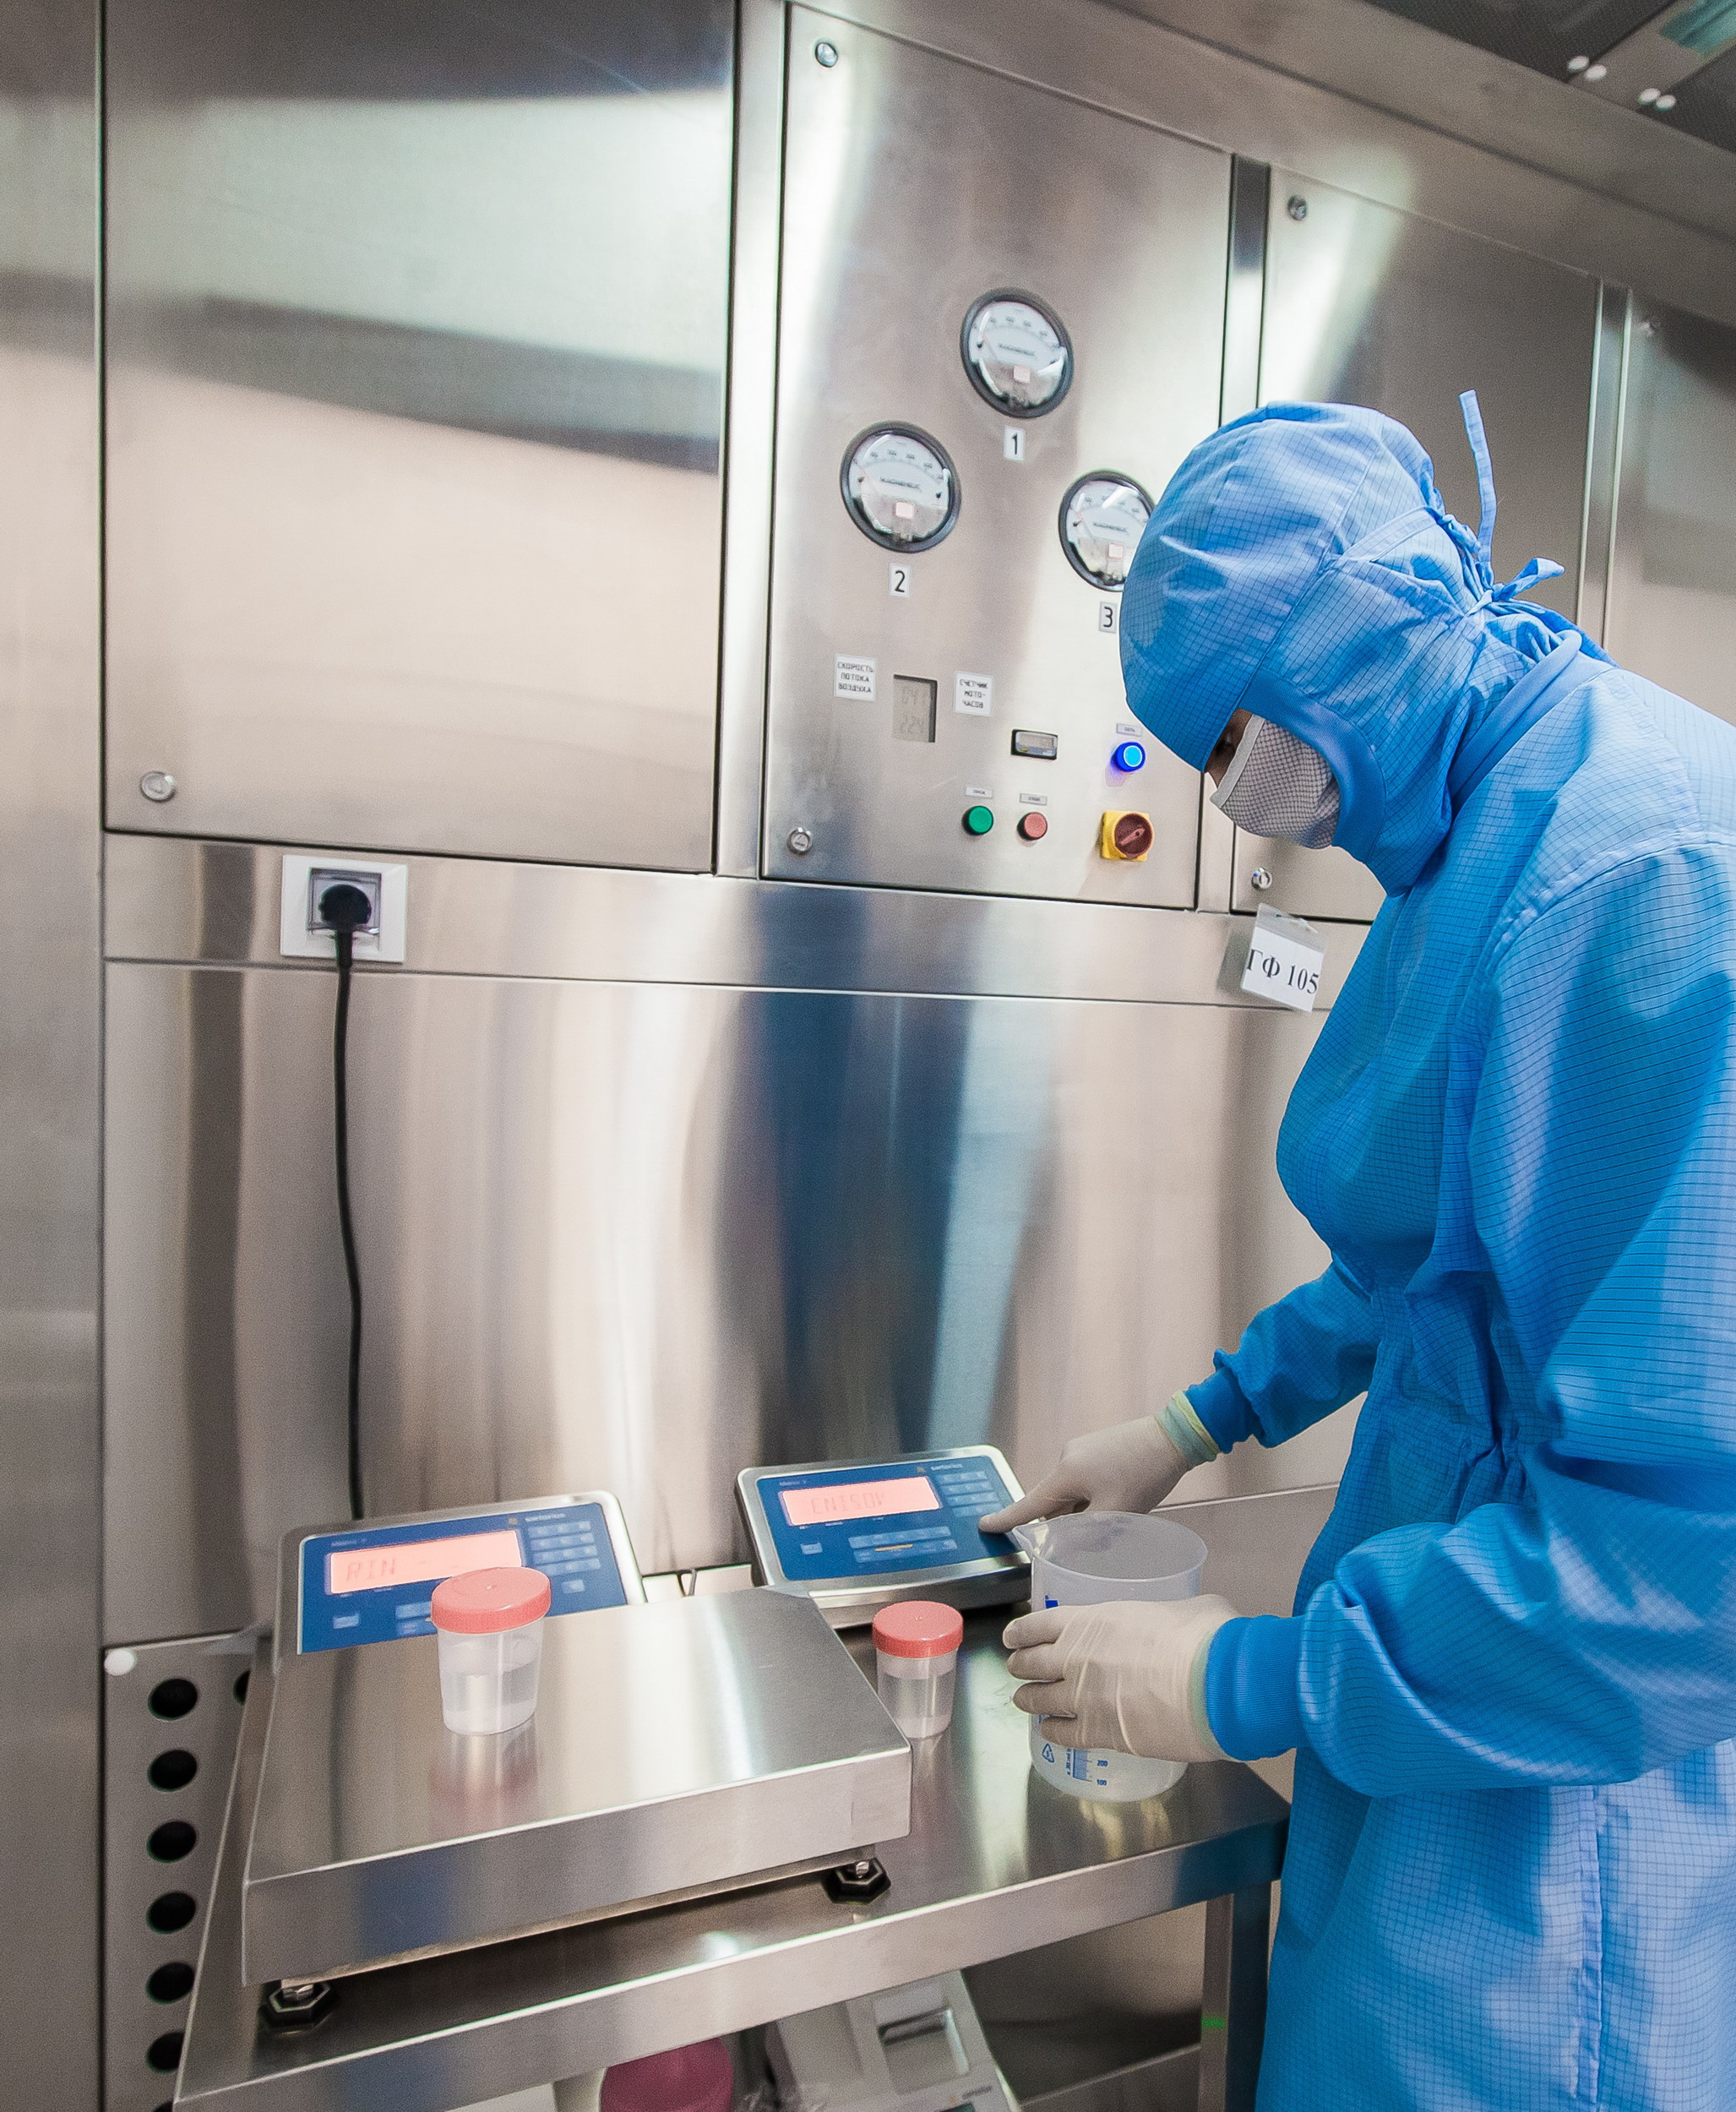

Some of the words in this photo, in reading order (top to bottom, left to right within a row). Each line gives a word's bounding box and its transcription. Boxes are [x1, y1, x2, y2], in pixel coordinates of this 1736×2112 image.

[1011, 433, 1019, 455] 1
[894, 570, 906, 593] 2
[1102, 606, 1113, 628] 3
[837, 661, 873, 672] СКОРОСТЬ
[841, 672, 869, 682] ПОТОКА
[838, 682, 872, 693] ВОЗДУХА
[1247, 949, 1281, 979] ГФ
[1287, 964, 1320, 995] 105
